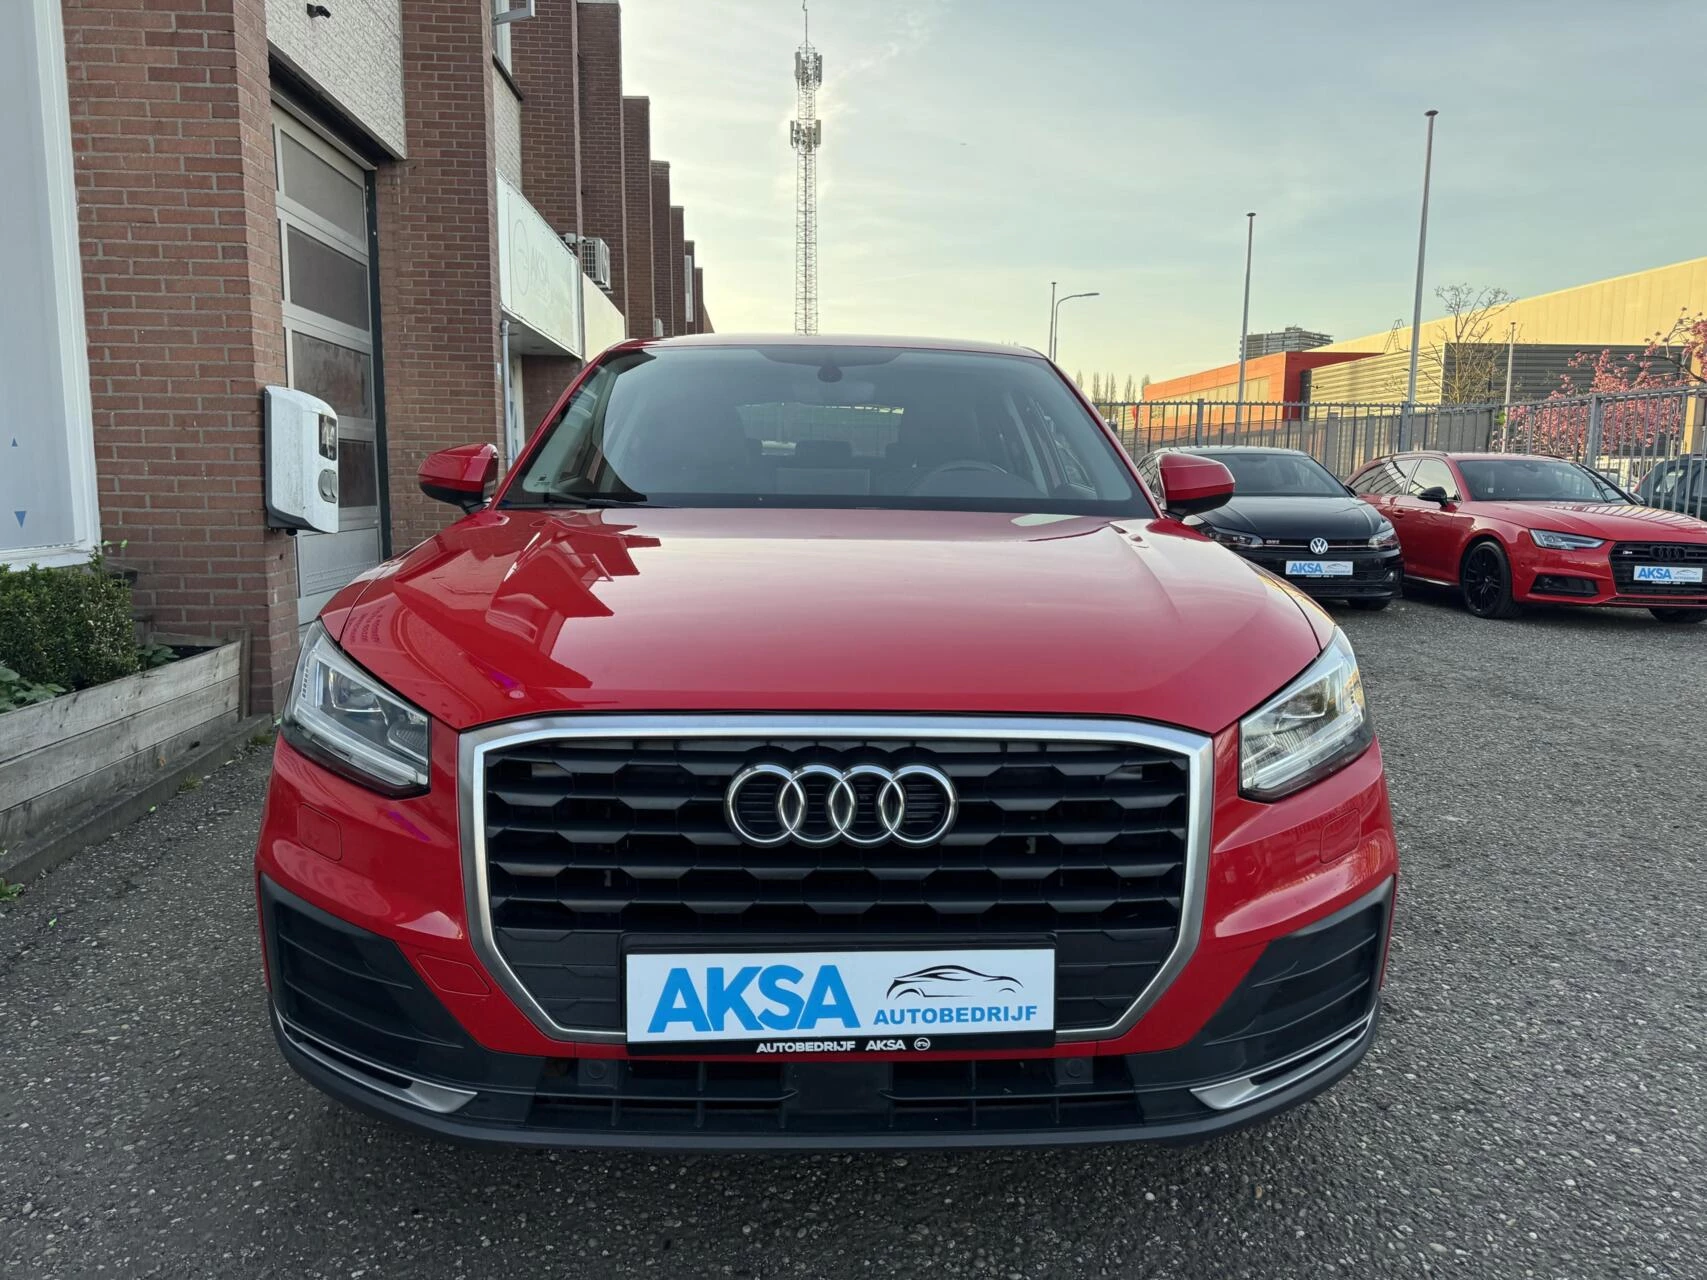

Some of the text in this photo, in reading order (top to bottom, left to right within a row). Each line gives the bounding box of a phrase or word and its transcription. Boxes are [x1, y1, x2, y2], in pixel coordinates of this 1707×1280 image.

[1290, 562, 1323, 573] AKSA
[1638, 568, 1672, 580] AKSA
[648, 965, 1038, 1033] AKSA AUTOBEDRIJF
[756, 1040, 906, 1053] AUTOBEDRIJF AKSA
